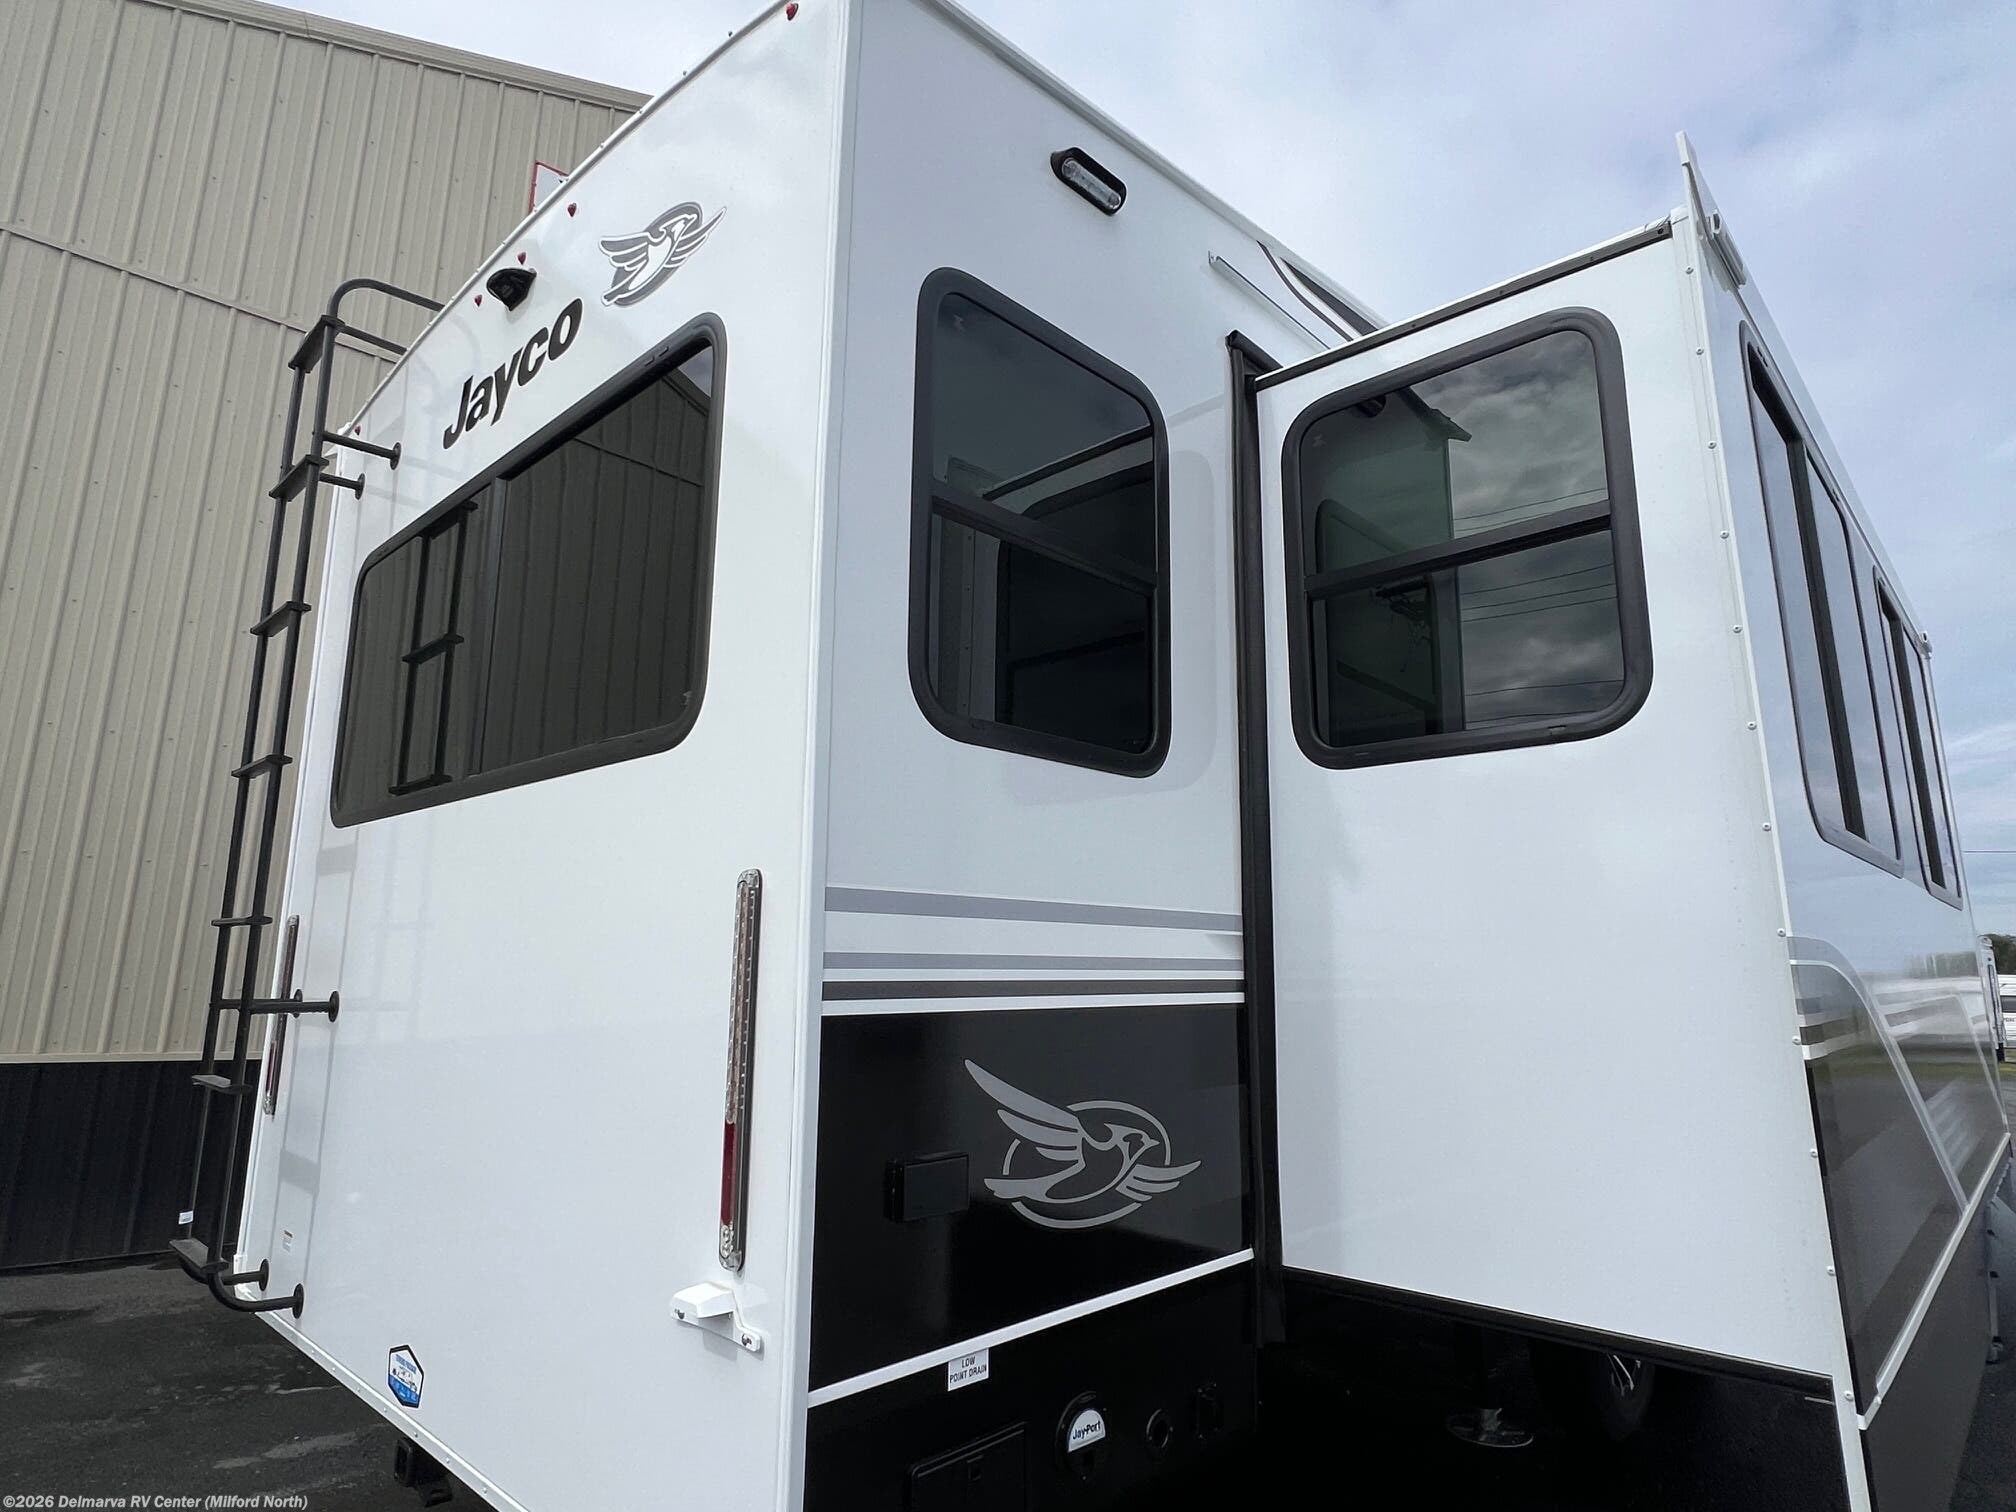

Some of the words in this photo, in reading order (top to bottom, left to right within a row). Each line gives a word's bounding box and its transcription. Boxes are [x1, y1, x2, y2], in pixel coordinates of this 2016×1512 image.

[443, 298, 583, 449] Jayco
[961, 1355, 976, 1368] LOW
[949, 1369, 968, 1383] POINT
[968, 1363, 987, 1377] DRAIN
